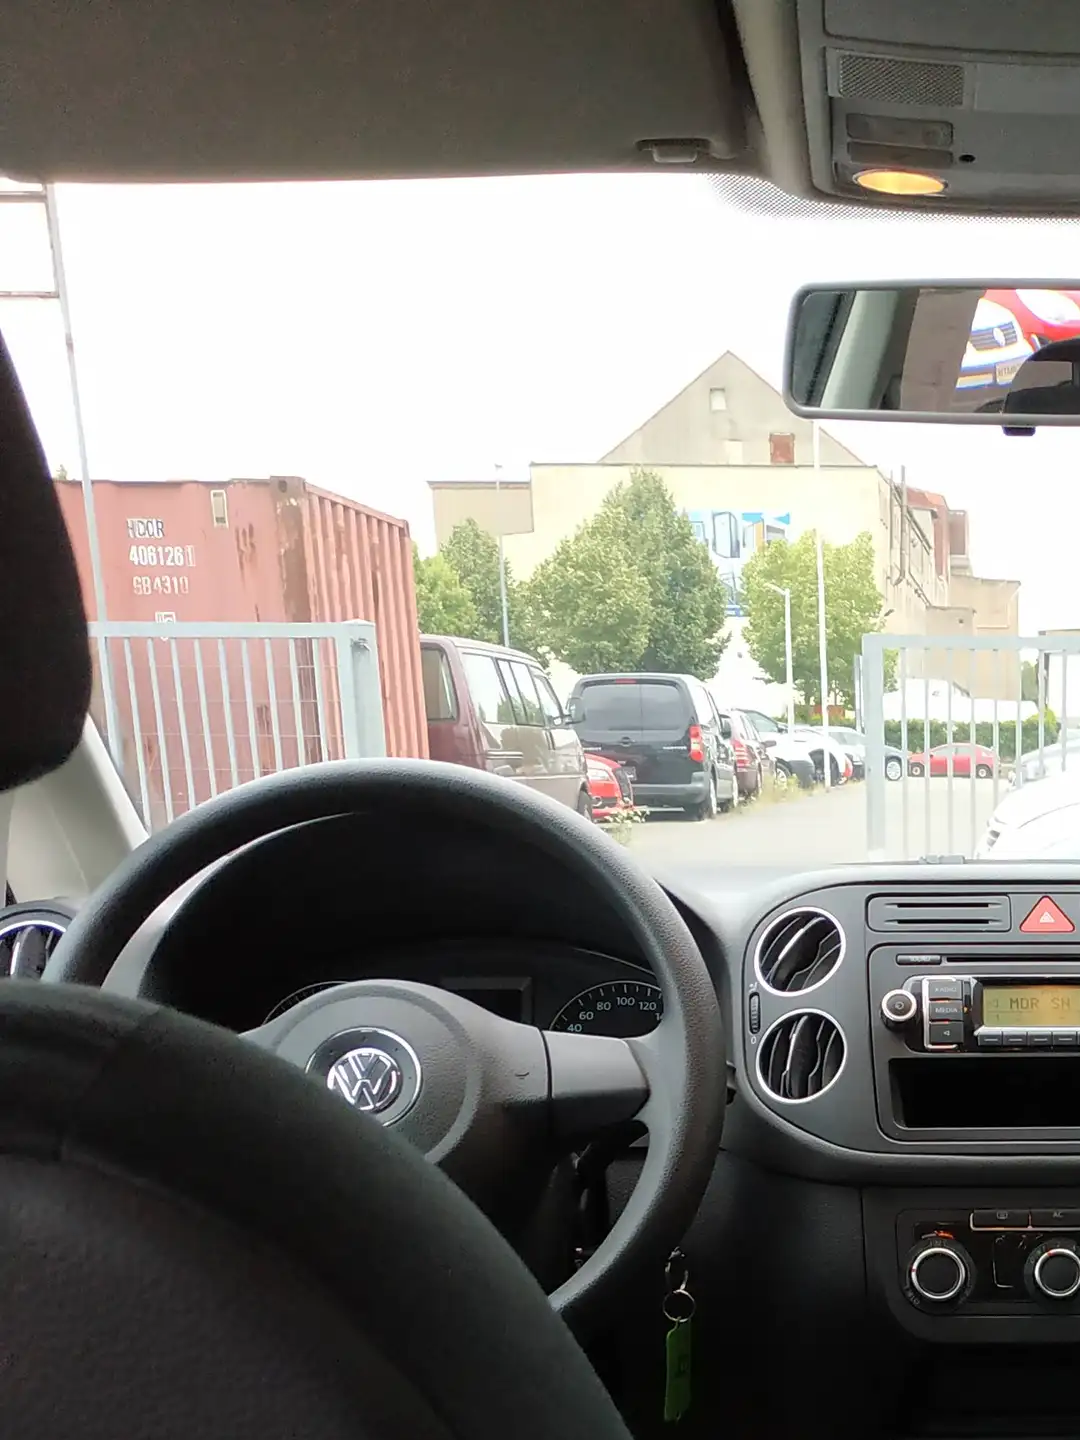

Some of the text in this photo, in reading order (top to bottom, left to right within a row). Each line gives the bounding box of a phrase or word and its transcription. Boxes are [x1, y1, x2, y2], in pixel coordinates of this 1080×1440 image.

[596, 1001, 611, 1011] 80
[616, 997, 635, 1006] 100
[638, 1001, 657, 1011] 120
[1009, 997, 1040, 1011] MDR
[579, 1011, 594, 1020] 60
[567, 1023, 582, 1032] 40
